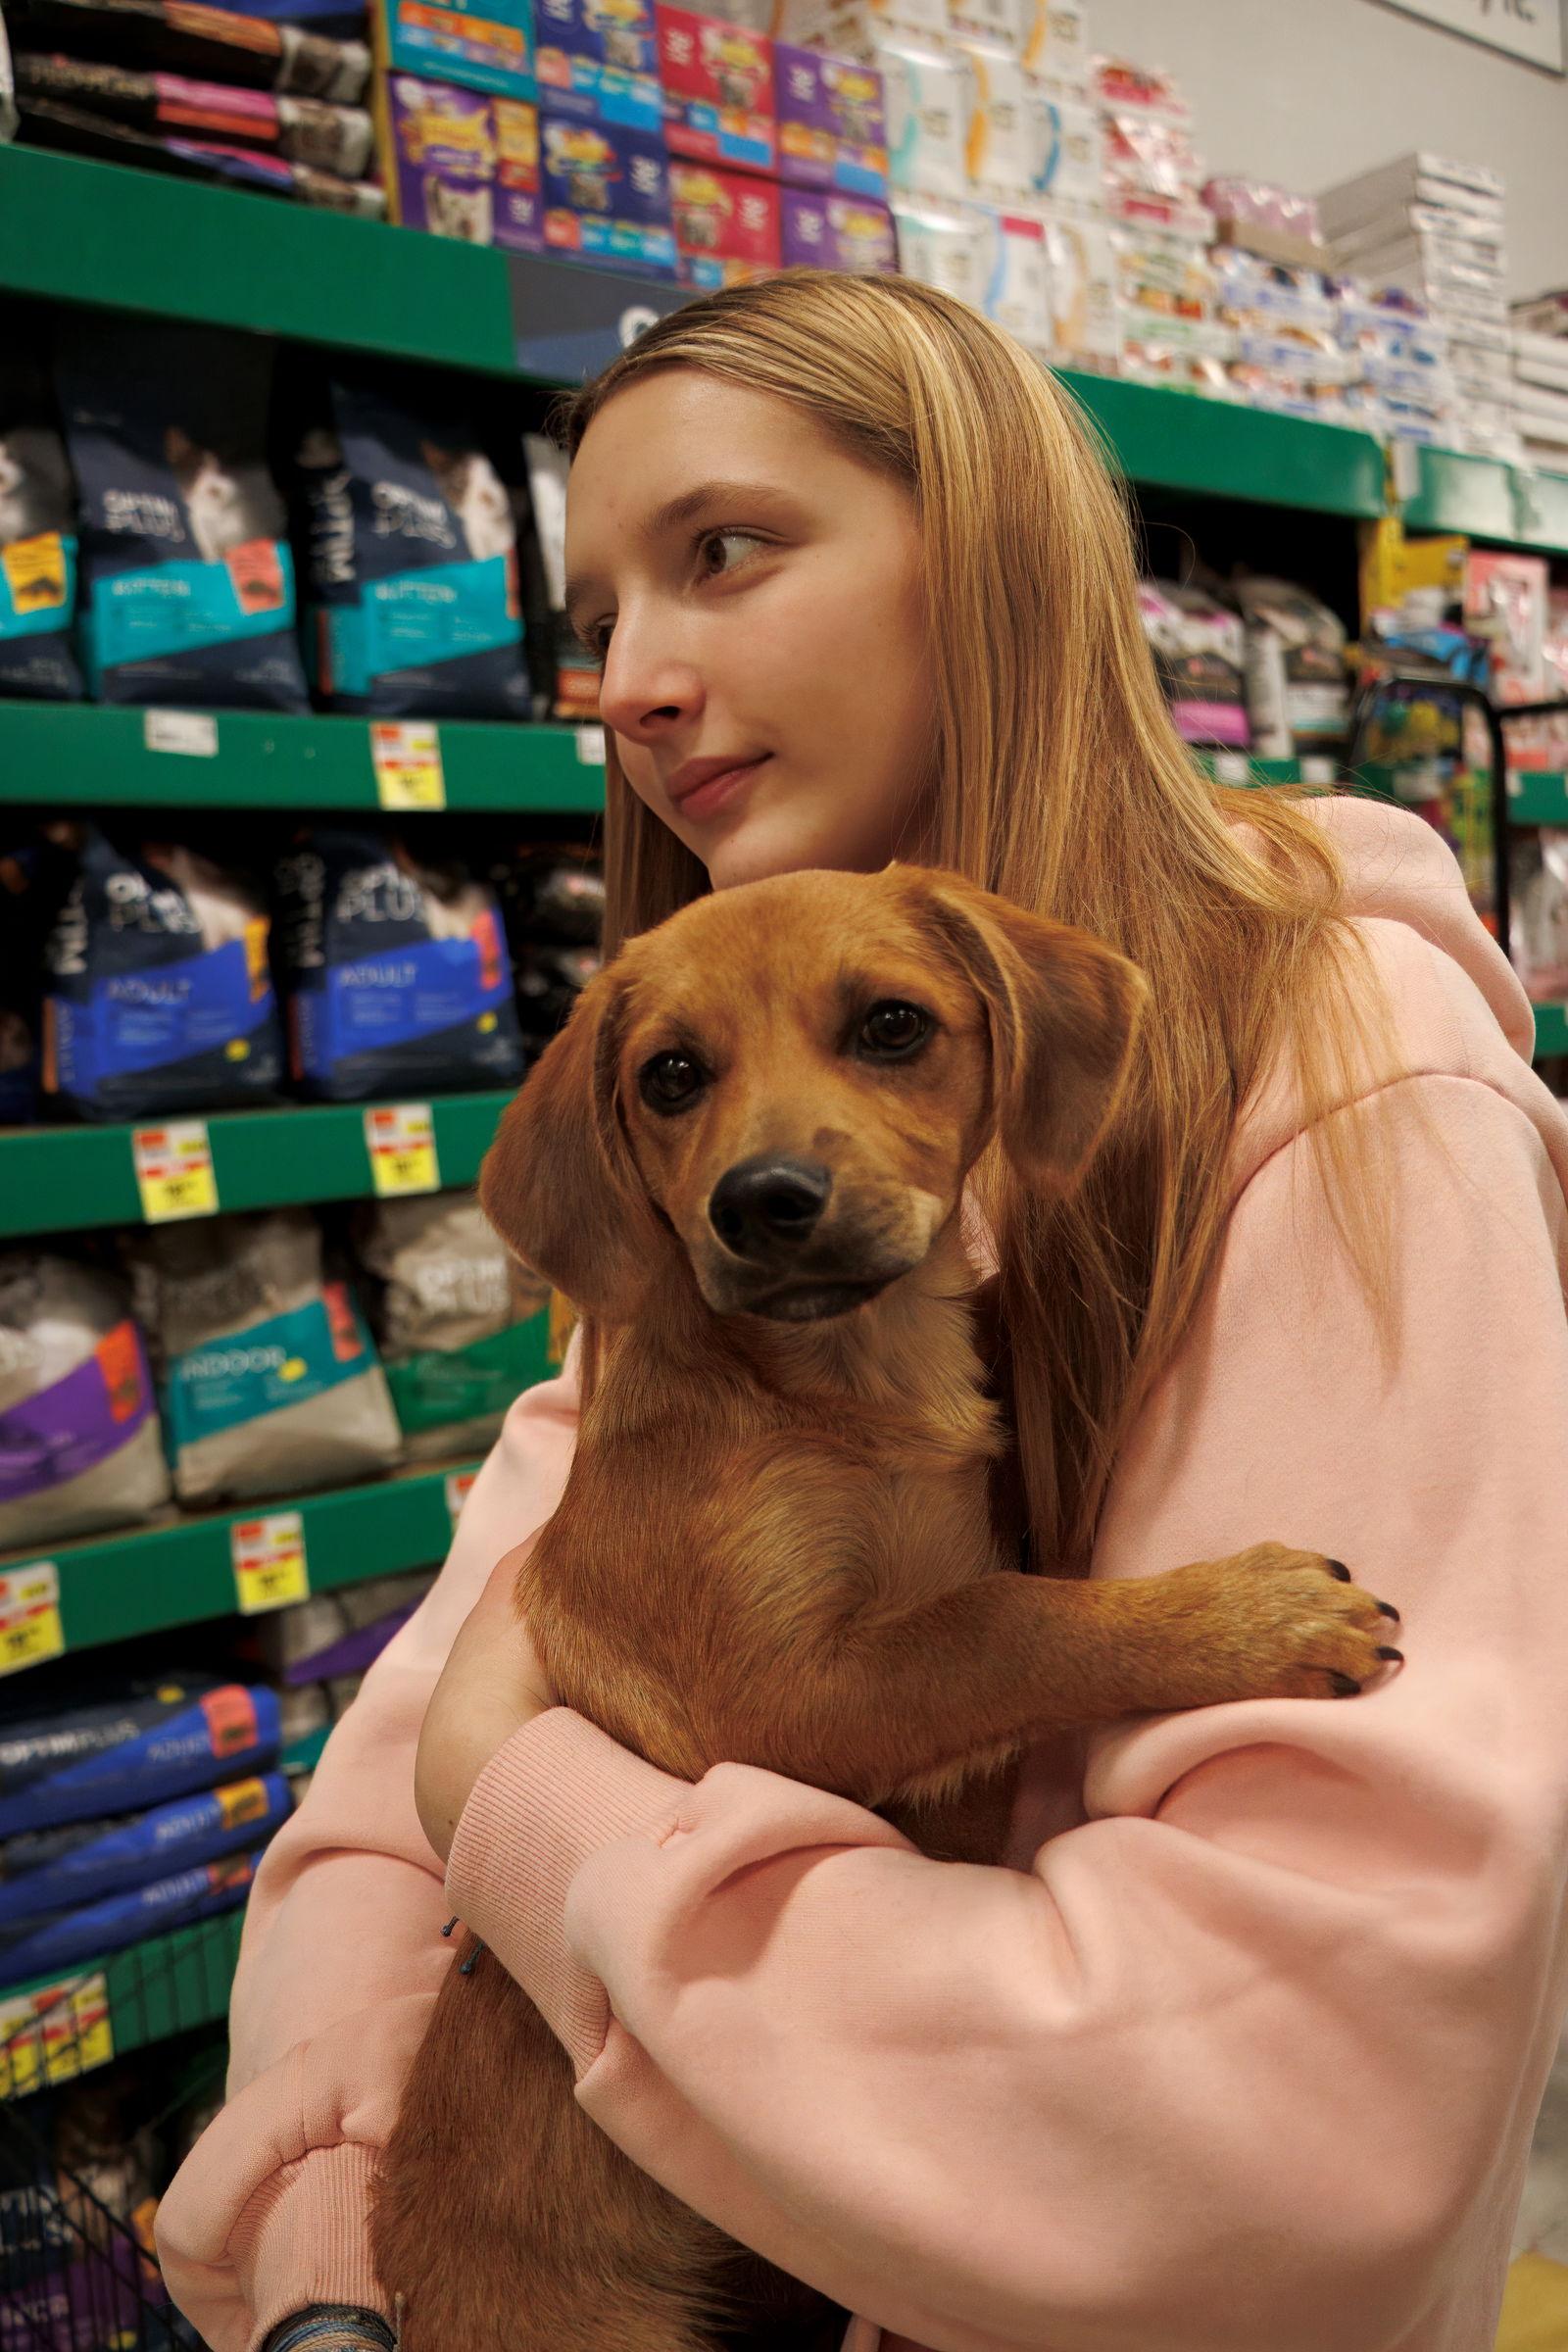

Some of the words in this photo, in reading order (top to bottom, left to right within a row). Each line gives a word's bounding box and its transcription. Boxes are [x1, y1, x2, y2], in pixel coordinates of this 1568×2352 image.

[340, 962, 416, 989] ADULT
[108, 978, 191, 1005] ADULT
[178, 1345, 287, 1380] INDOOR
